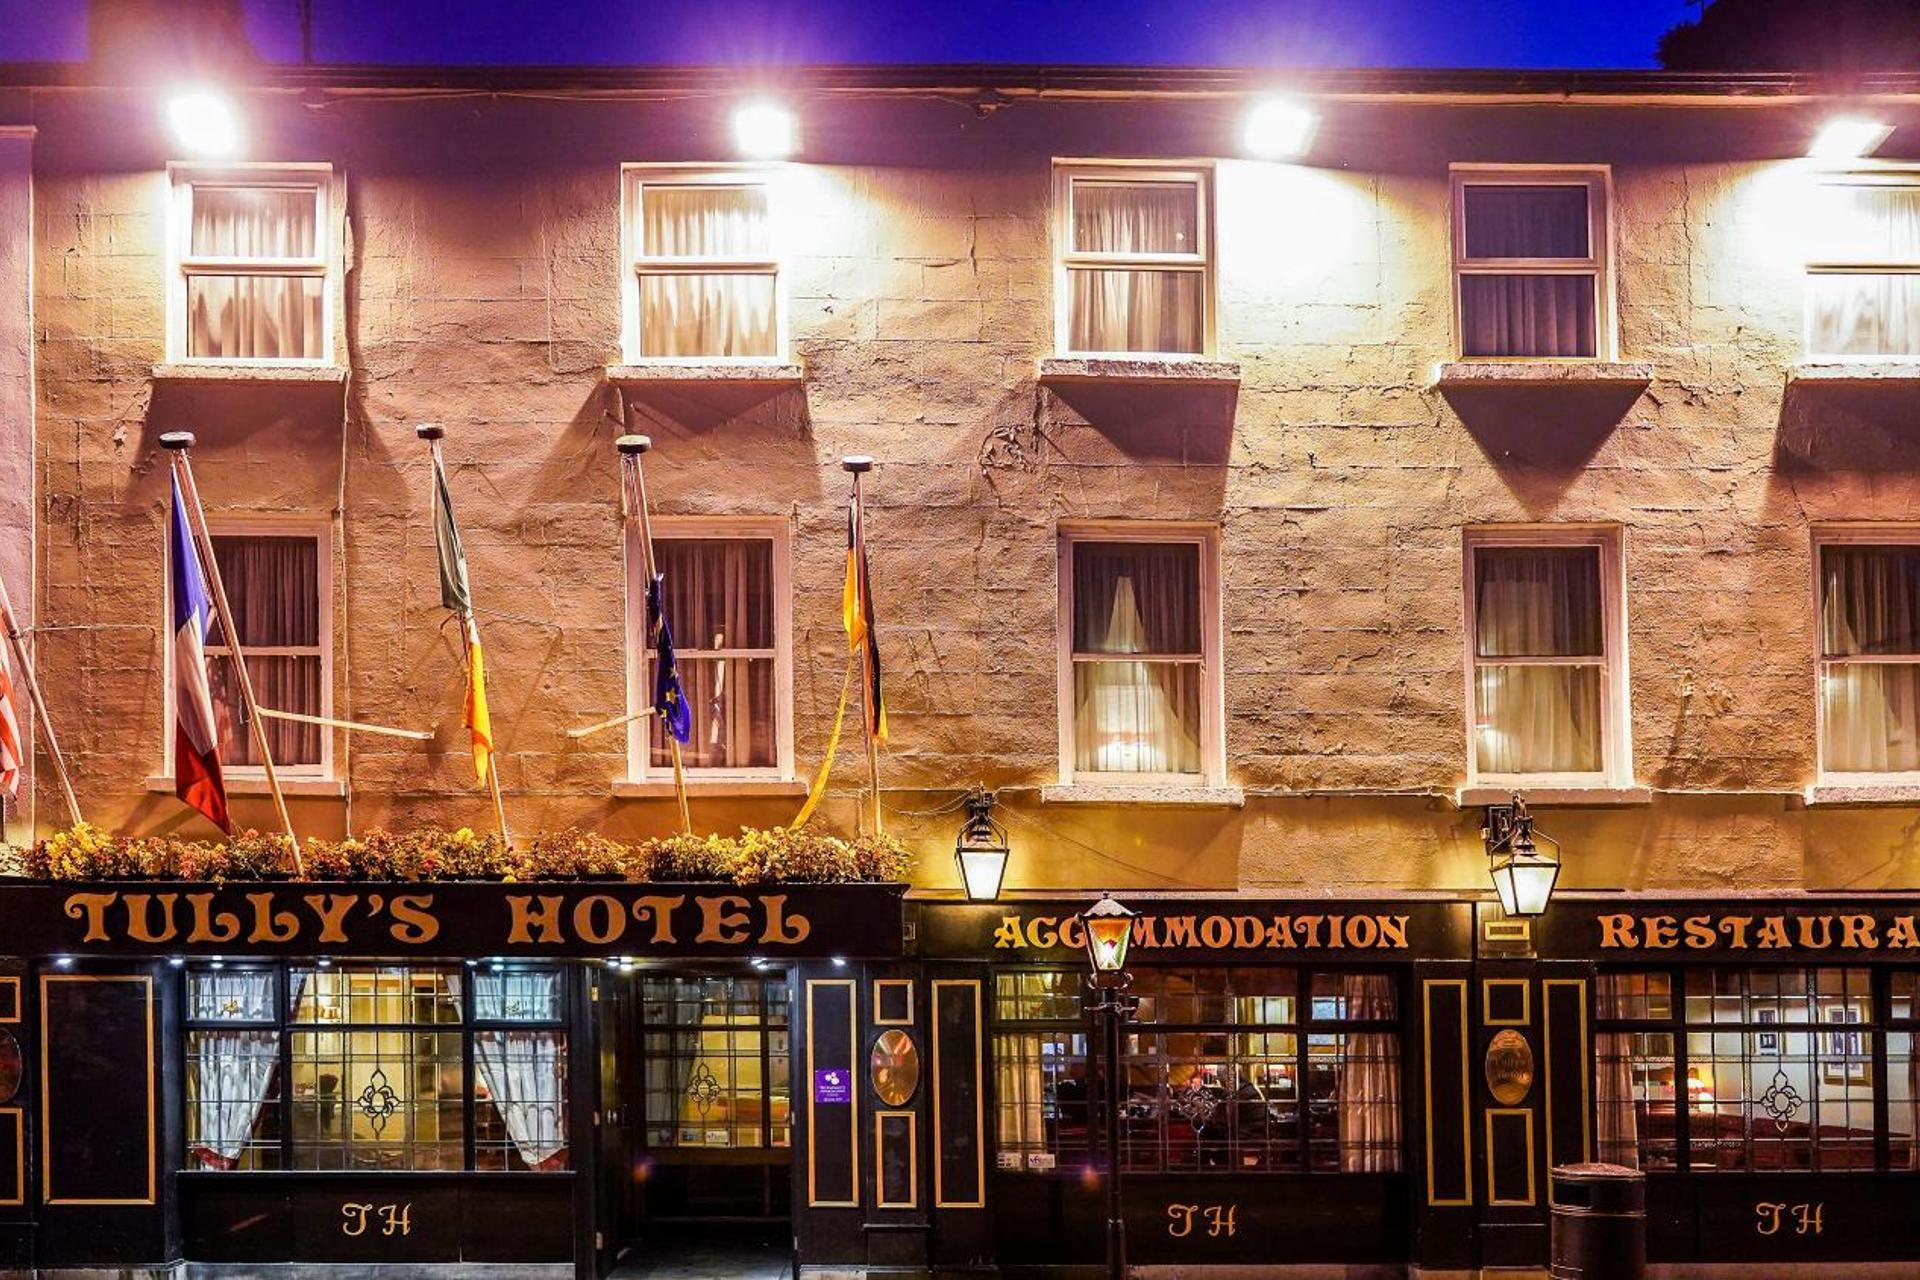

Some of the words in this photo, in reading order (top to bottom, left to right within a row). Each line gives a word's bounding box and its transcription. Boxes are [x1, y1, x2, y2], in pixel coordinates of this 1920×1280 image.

[64, 891, 440, 944] TULLY'S
[505, 893, 810, 944] HOTEL
[994, 915, 1409, 949] ACCMMODATION
[1598, 913, 1920, 949] RESTAURA
